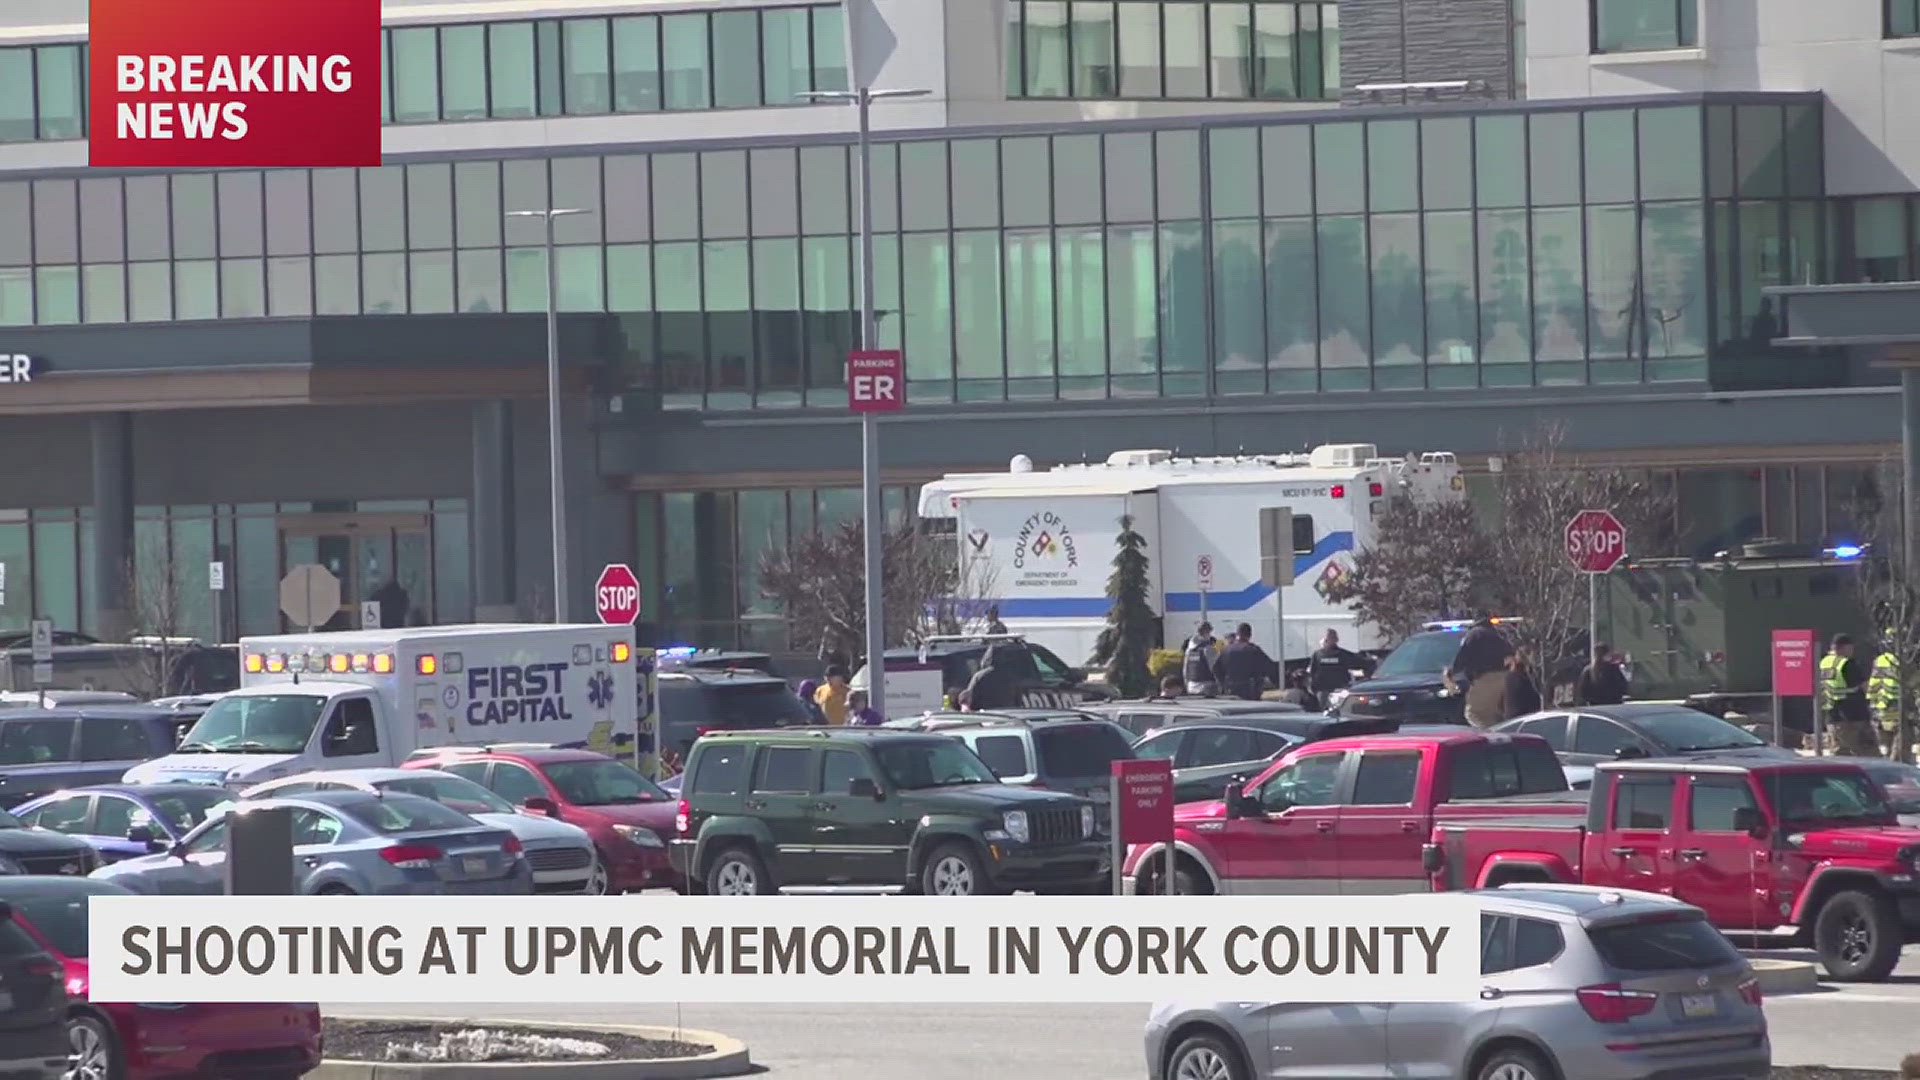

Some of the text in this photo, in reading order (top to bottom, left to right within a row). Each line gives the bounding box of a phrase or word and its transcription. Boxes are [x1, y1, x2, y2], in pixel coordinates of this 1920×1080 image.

[853, 359, 895, 368] PARKING
[854, 375, 895, 400] ER
[1014, 511, 1079, 569] COUNTY OF YORK
[1570, 530, 1620, 553] STOP
[600, 586, 636, 611] STOP
[468, 662, 569, 700] FIRST
[466, 696, 573, 727] CAPITAL
[1125, 773, 1168, 784] EMERGENCY
[1131, 785, 1163, 795] PARKING
[1137, 798, 1158, 809] ONLY
